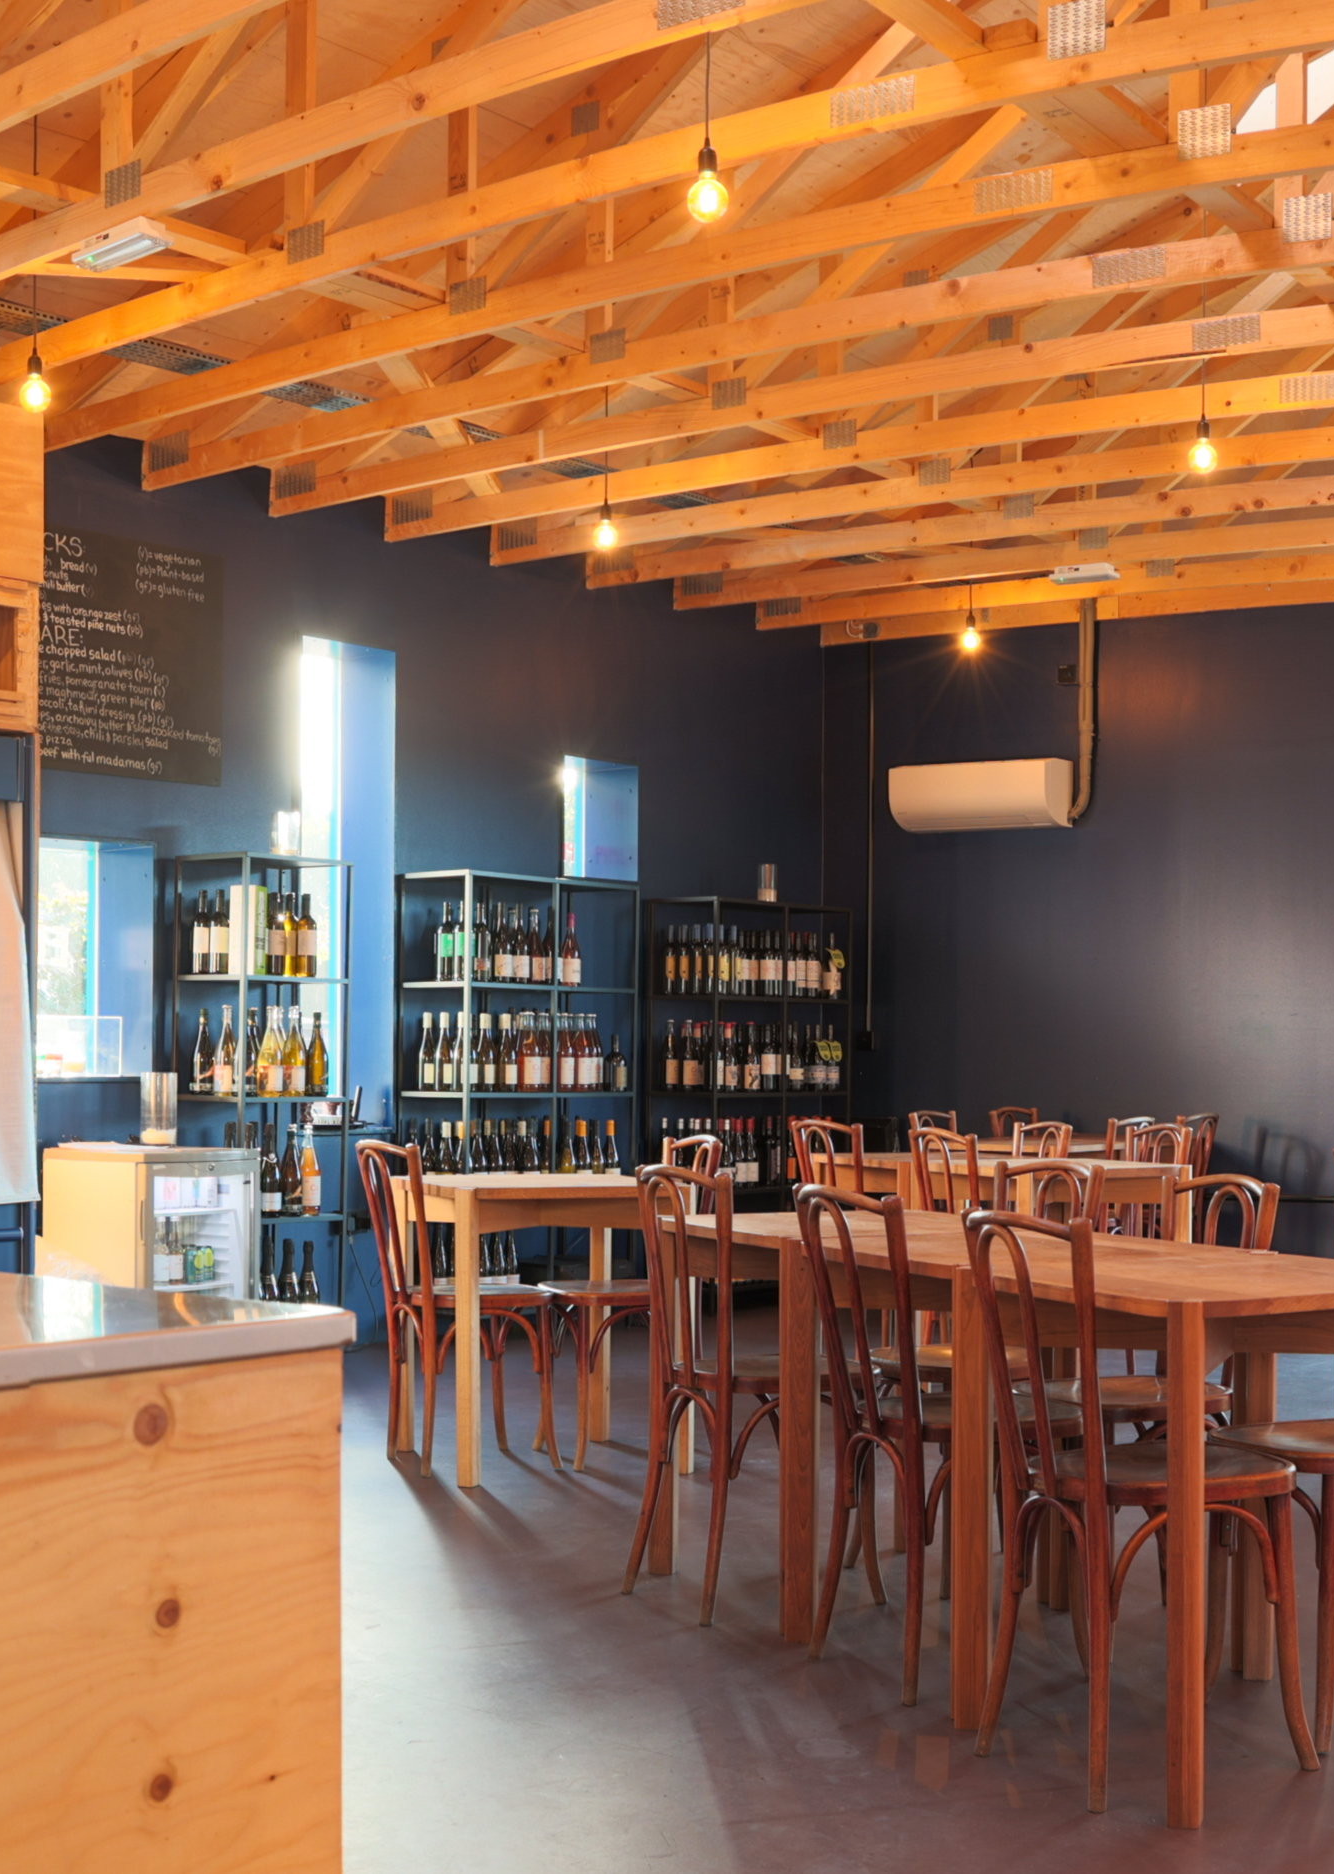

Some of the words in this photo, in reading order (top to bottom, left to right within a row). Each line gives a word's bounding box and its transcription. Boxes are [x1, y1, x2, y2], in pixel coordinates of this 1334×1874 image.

[60, 557, 84, 573] bread
[56, 581, 79, 594] butter
[187, 588, 205, 602] free
[53, 603, 71, 614] with
[72, 606, 104, 622] orange
[104, 611, 122, 621] zest
[50, 612, 86, 629] toasted
[87, 620, 104, 631] pine
[105, 622, 126, 635] nuts
[126, 624, 144, 639] (pb)
[45, 644, 87, 660] chopped
[88, 647, 116, 662] salad
[65, 675, 127, 694] pomegranate
[100, 693, 128, 708] green
[129, 695, 150, 710] pilaf
[98, 706, 135, 725] dressing
[45, 734, 73, 747] pizza
[151, 726, 184, 740] cooked
[61, 748, 80, 760] with
[96, 755, 146, 771] madamas
